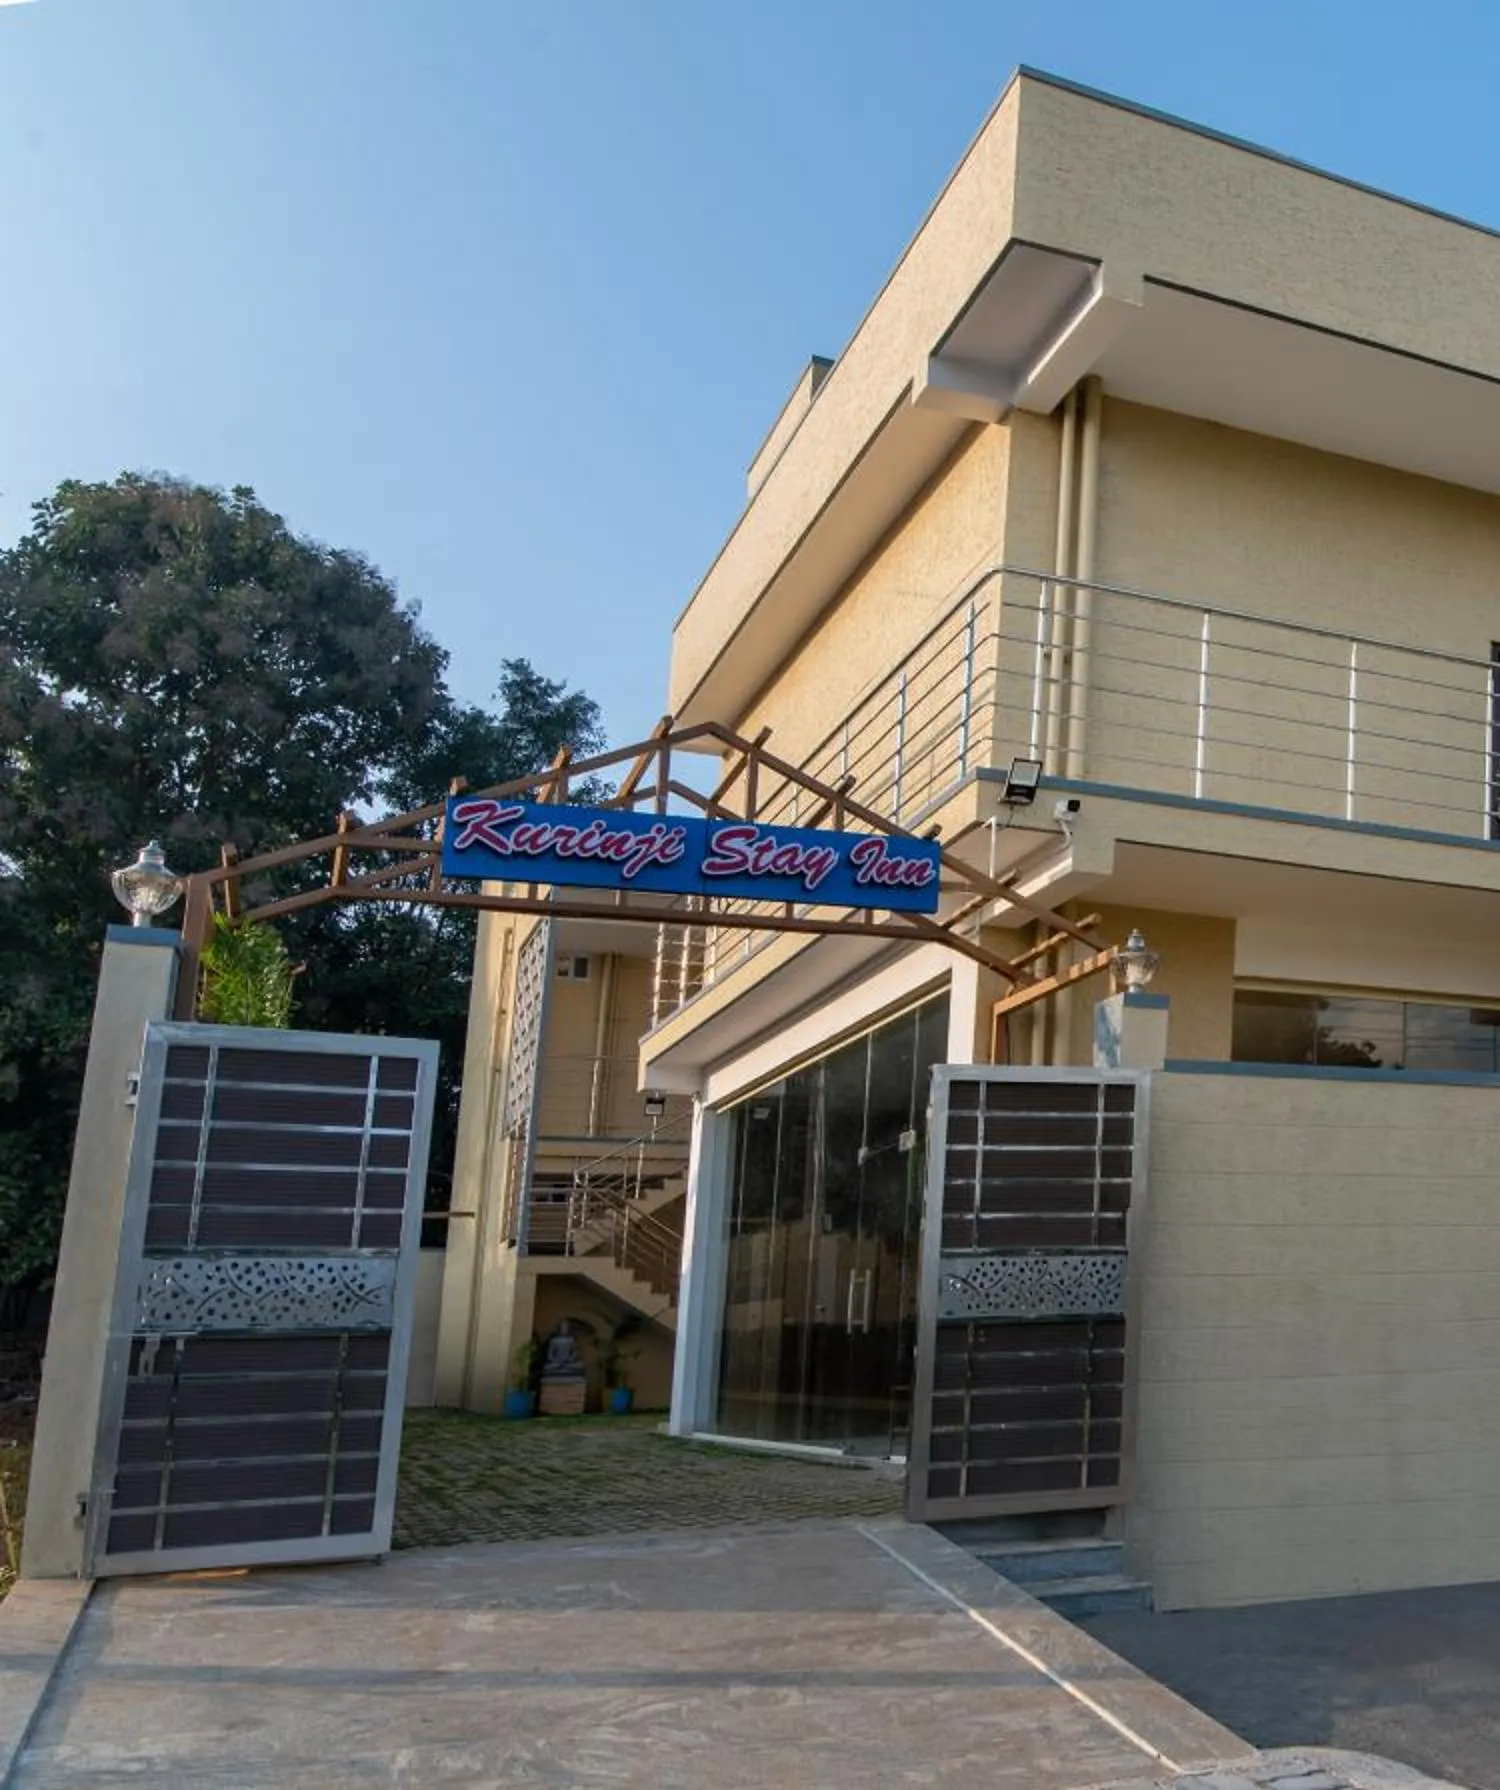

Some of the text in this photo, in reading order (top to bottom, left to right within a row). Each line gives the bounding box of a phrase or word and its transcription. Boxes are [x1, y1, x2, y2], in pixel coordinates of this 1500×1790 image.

[452, 800, 936, 891] Kurinji Stay Inn
